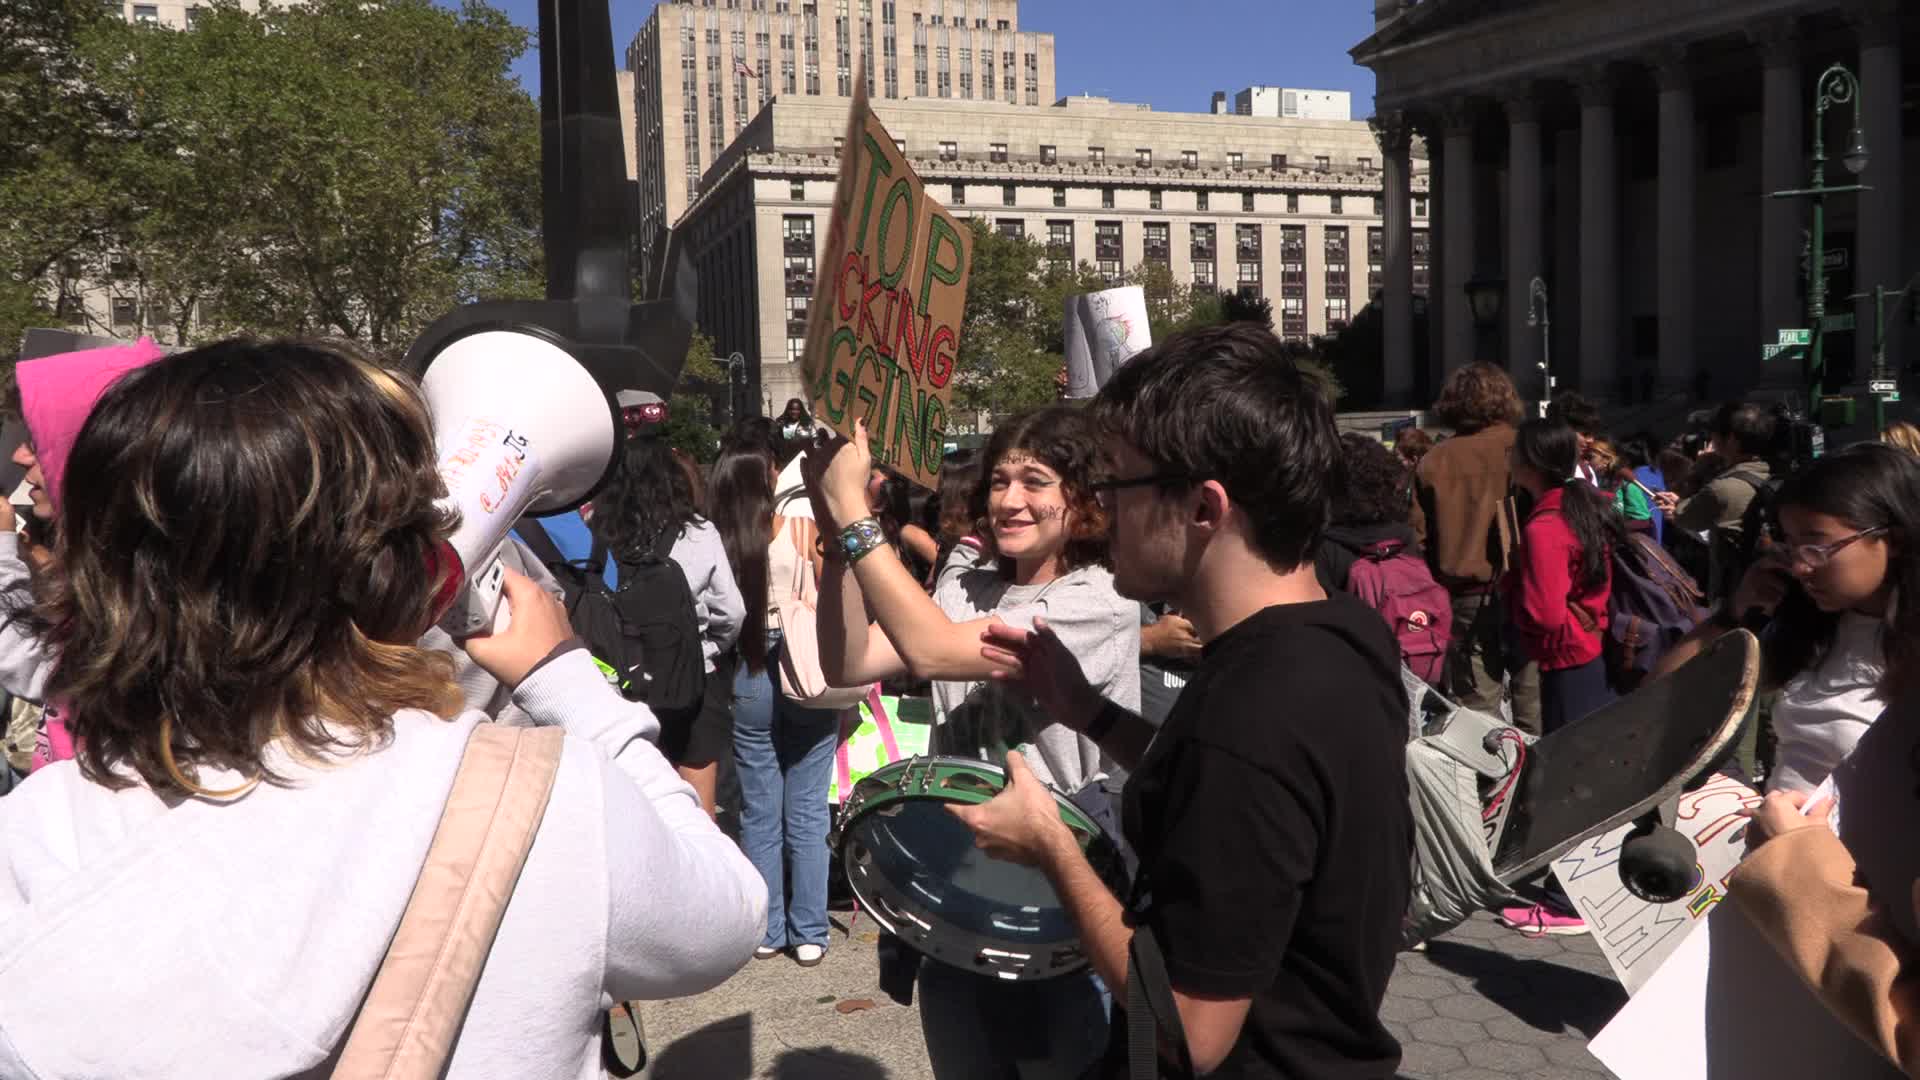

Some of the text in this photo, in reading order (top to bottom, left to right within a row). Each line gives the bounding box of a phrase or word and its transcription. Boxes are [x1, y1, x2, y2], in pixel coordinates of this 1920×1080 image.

[844, 122, 964, 316] TOP
[833, 238, 956, 388] CKING
[1779, 331, 1799, 343] PEARL
[814, 322, 946, 477] GGING
